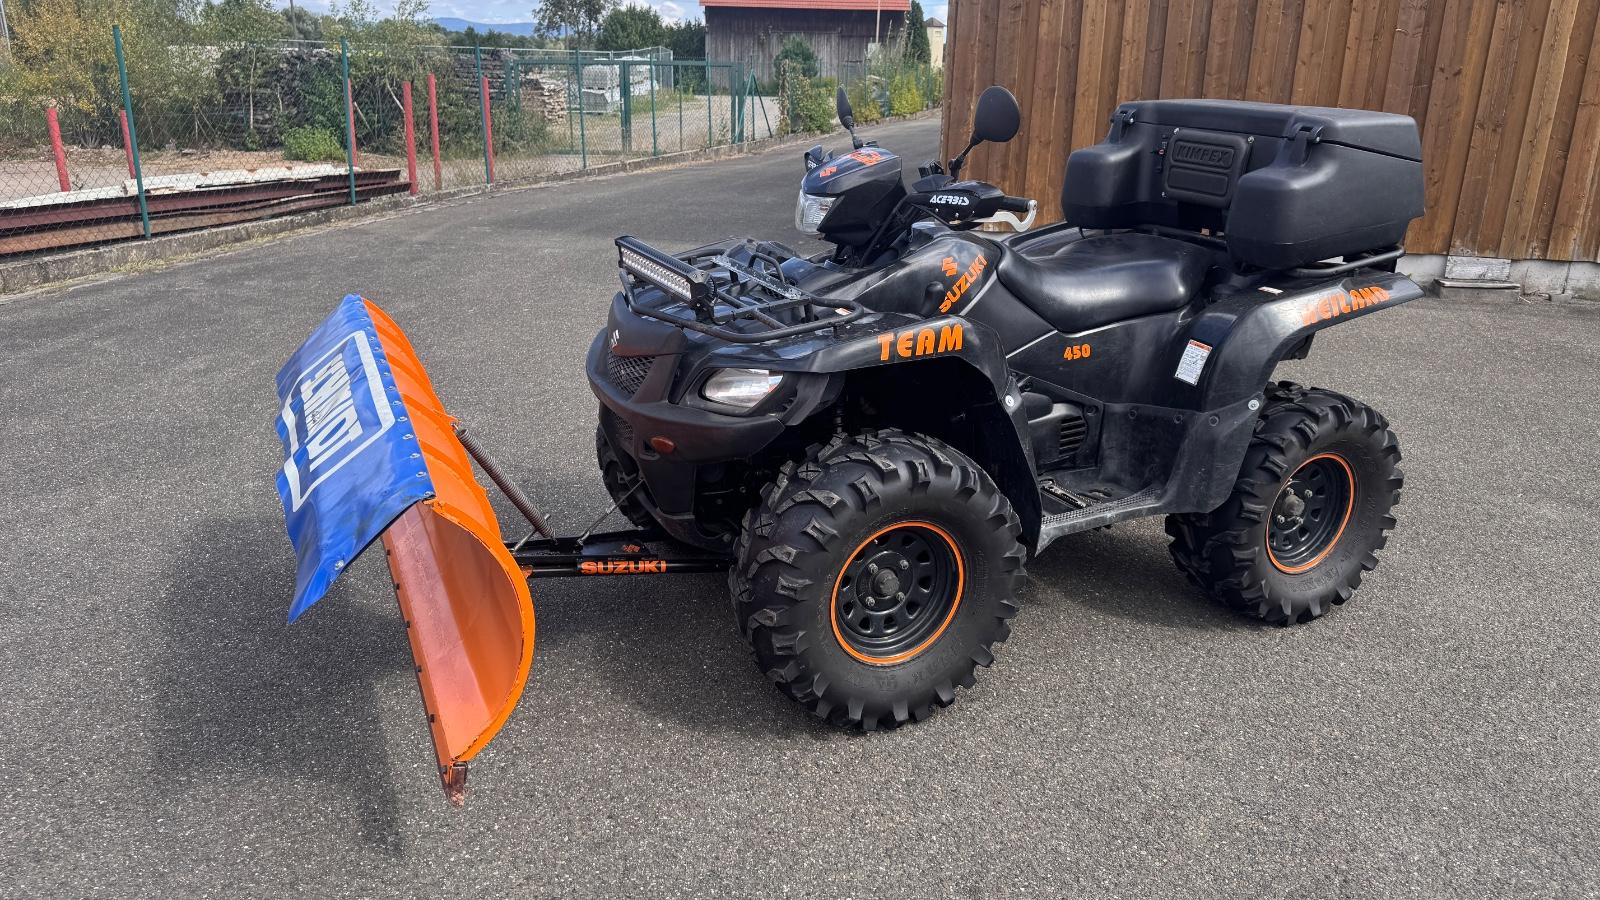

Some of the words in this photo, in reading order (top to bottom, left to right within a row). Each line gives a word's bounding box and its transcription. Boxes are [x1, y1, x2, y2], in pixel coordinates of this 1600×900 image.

[1175, 143, 1231, 168] KIMPEX
[939, 253, 988, 314] SUZUKI
[877, 323, 964, 361] TEAM
[1063, 343, 1091, 361] 450
[580, 560, 667, 576] SUZUKI
